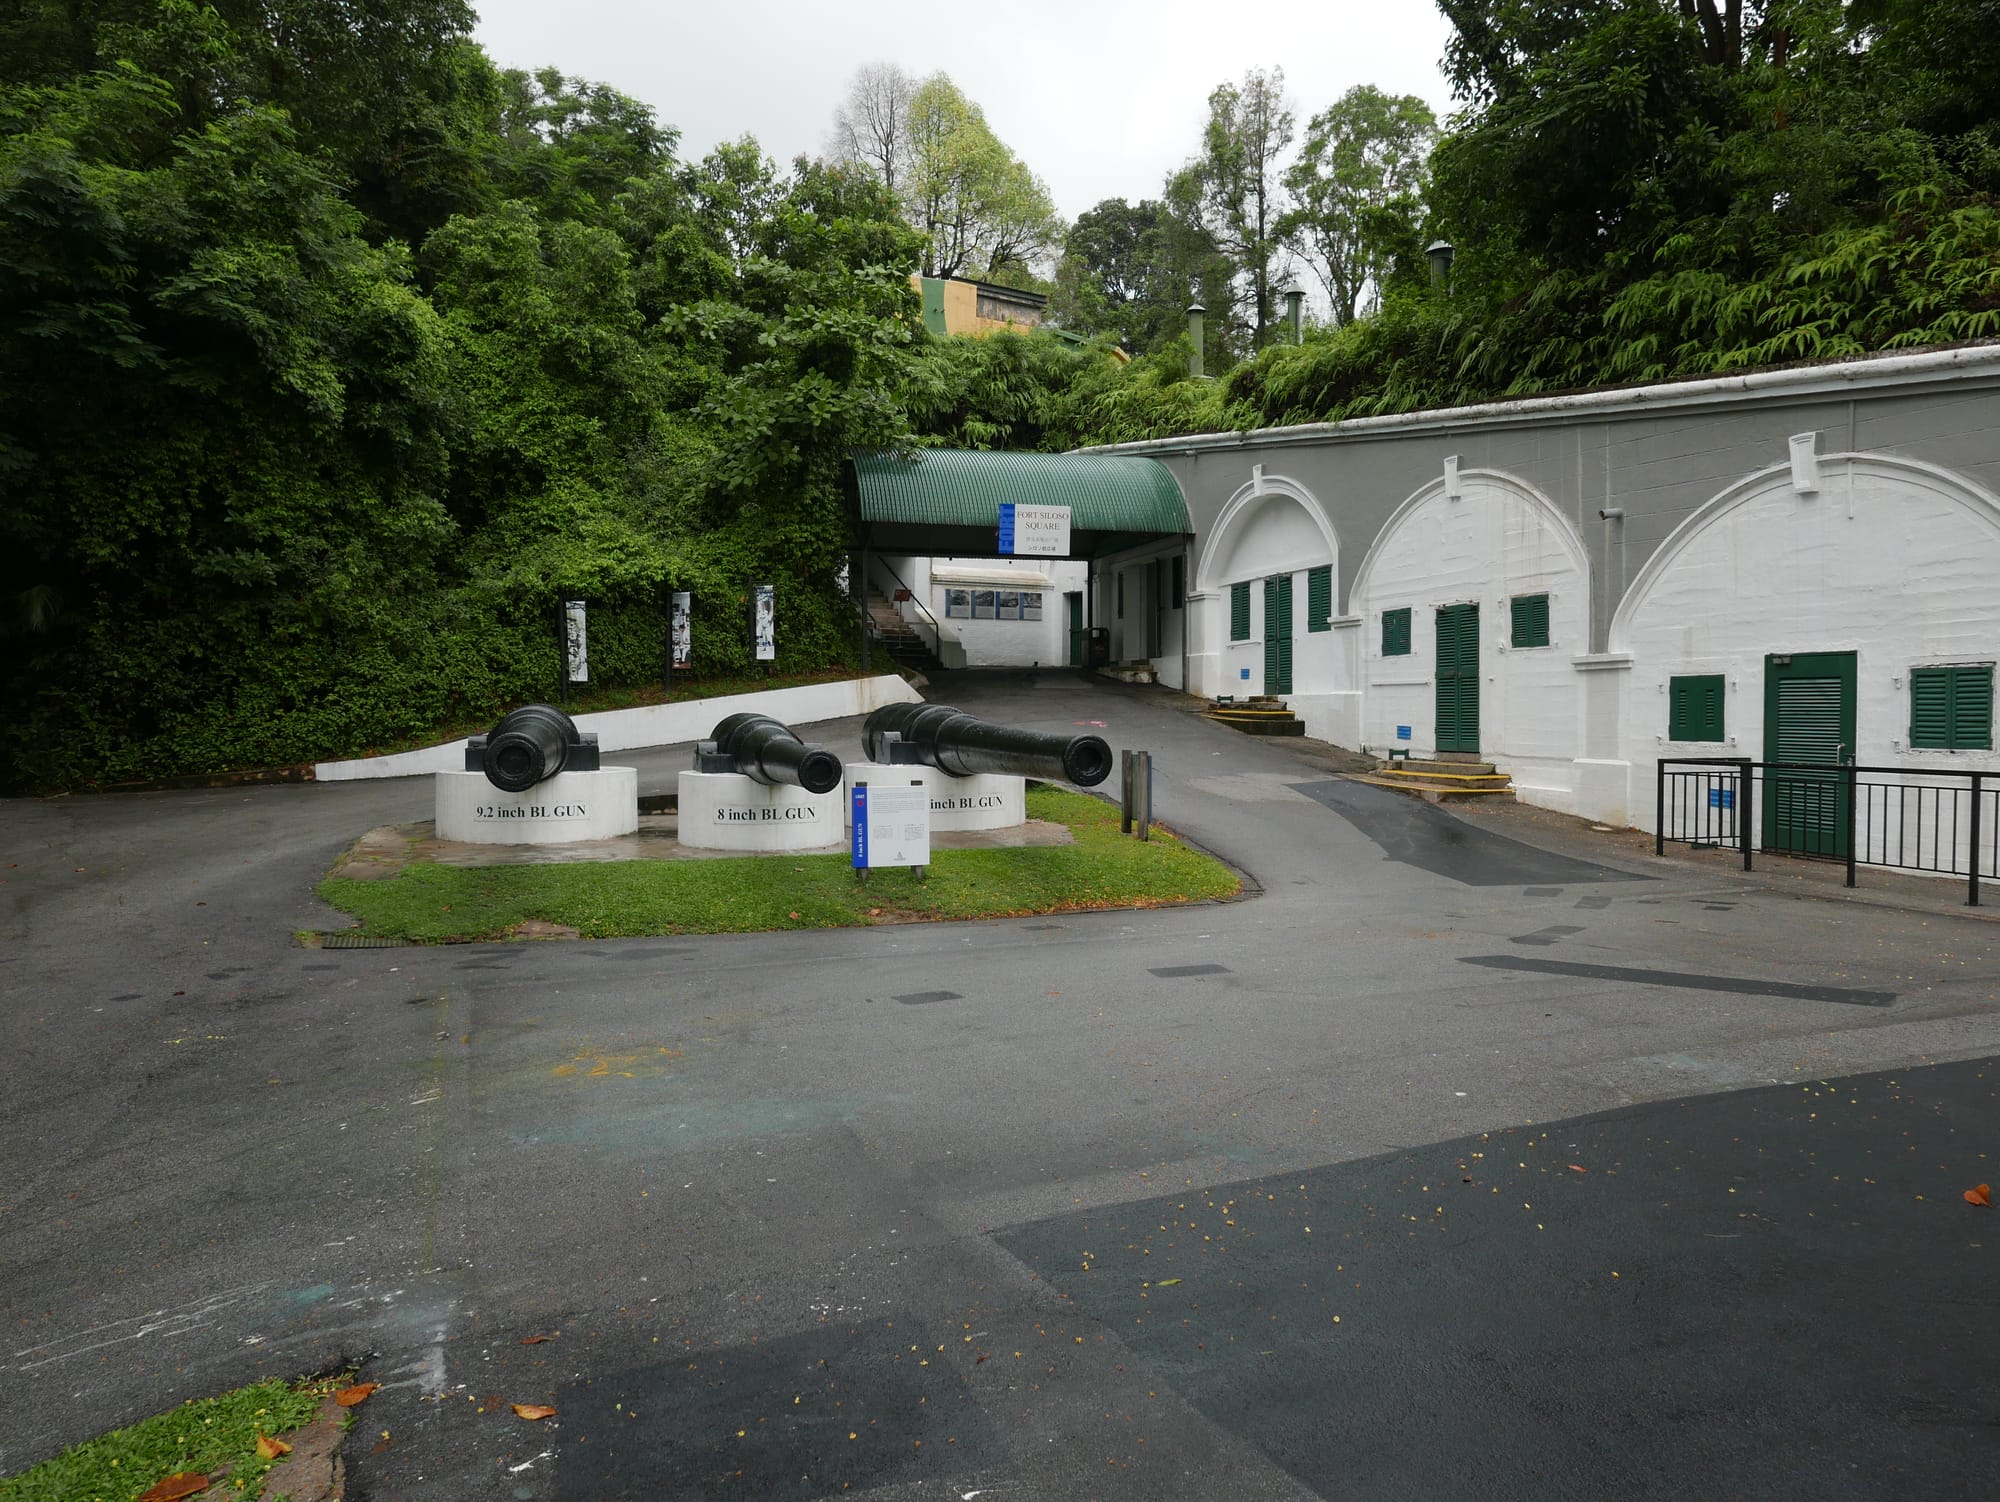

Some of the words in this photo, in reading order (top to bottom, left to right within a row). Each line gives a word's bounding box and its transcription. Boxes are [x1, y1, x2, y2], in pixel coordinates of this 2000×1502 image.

[1017, 511, 1038, 520] FORT
[1040, 512, 1069, 520] SILOSO
[999, 505, 1014, 551] FORT
[1025, 522, 1061, 531] SQUARE
[930, 798, 955, 809] inch
[959, 798, 977, 809] BL
[978, 796, 1003, 808] GUN
[476, 806, 494, 818] 9.2
[497, 806, 526, 818] inch
[530, 806, 551, 818] BL
[553, 805, 587, 817] GUN
[717, 808, 725, 820] 8
[728, 808, 757, 820] inch
[761, 808, 782, 820] BL
[785, 806, 816, 819] GUN
